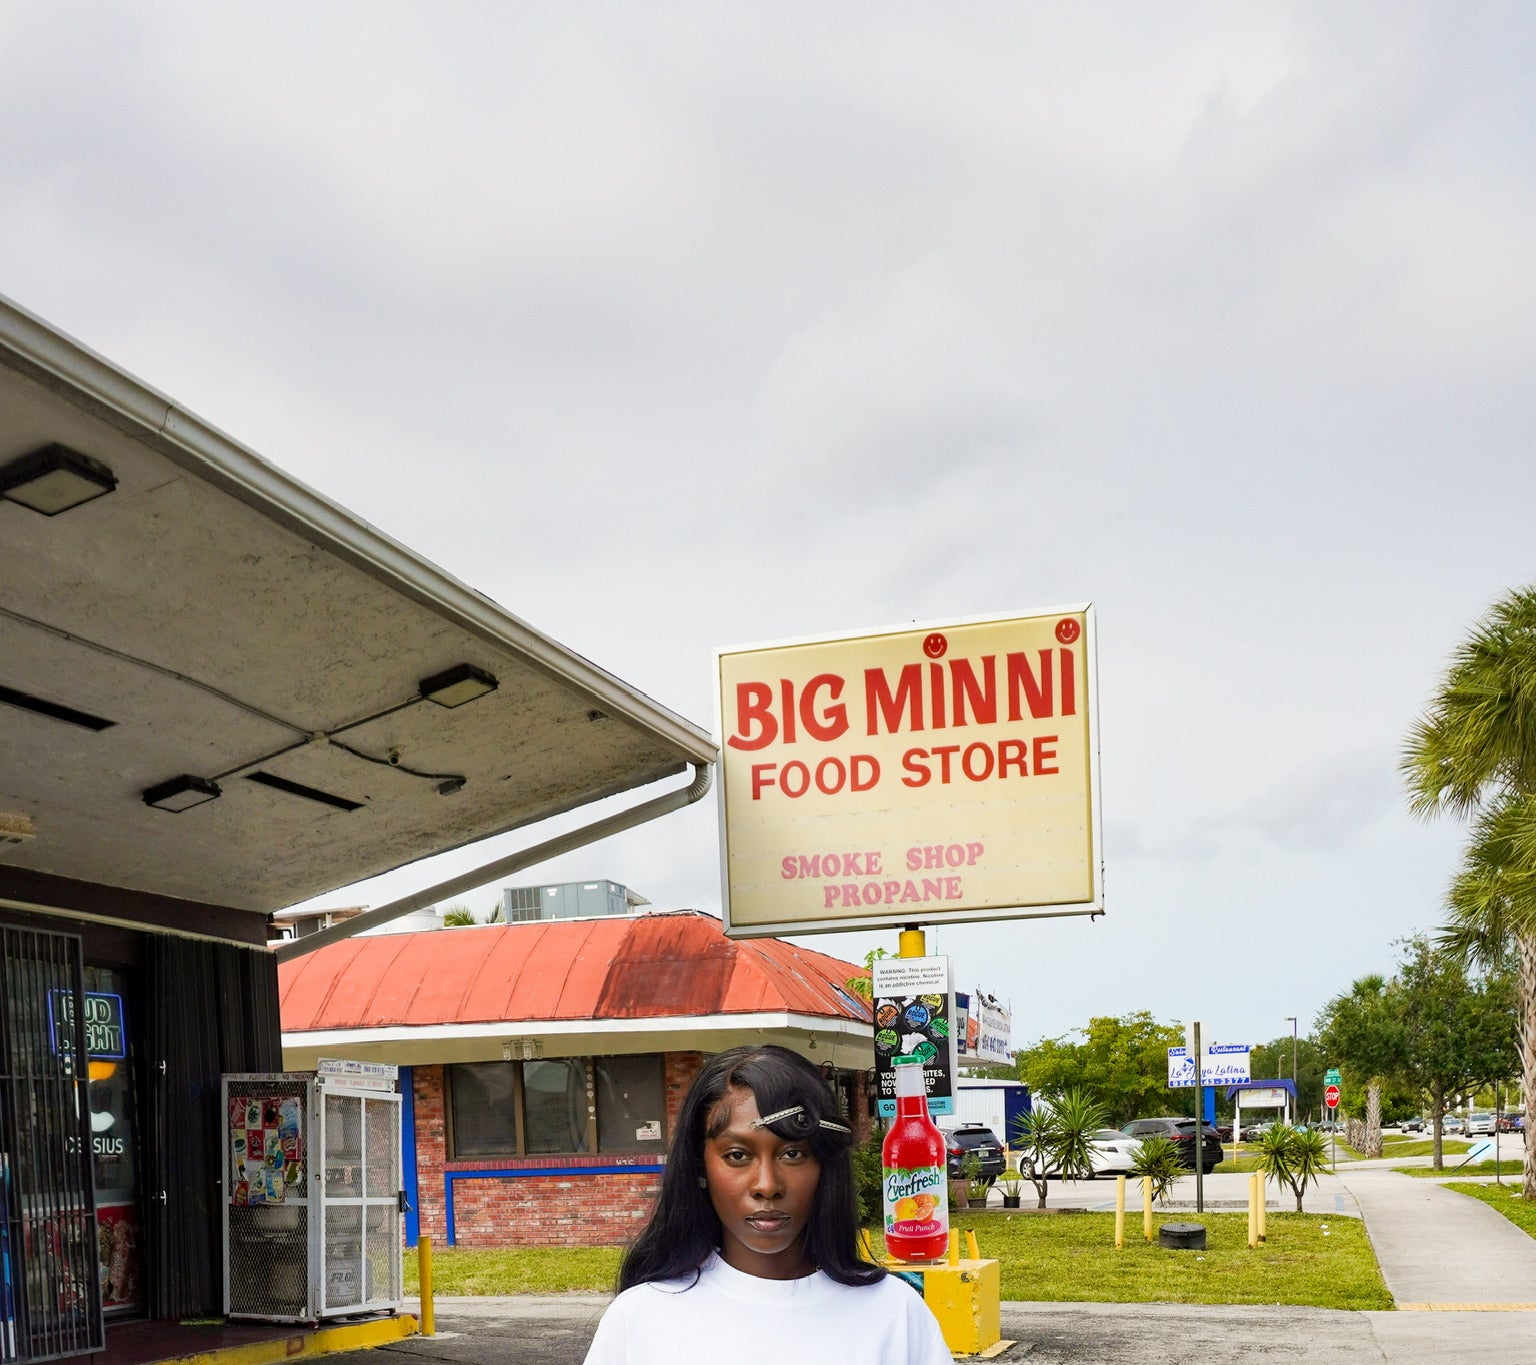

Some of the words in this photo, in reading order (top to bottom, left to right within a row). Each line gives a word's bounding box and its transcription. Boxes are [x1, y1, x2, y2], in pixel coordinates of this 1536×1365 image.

[727, 673, 850, 751] BIG
[752, 755, 881, 801] FOOD
[901, 735, 1060, 788] STORE
[781, 851, 883, 880] SMOKE
[906, 842, 985, 872] SHOP
[823, 876, 964, 909] PROPANE
[921, 965, 941, 973] product
[892, 980, 915, 988] addictive
[908, 1009, 925, 1018] ROGUE
[879, 1033, 896, 1041] ROGUE
[1211, 1045, 1247, 1054] Restaurant
[1170, 1067, 1182, 1078] La
[1186, 1065, 1213, 1079] Jya
[1215, 1064, 1247, 1076] Latina
[1326, 1092, 1339, 1101] STOP
[887, 1167, 940, 1202] Everfresh
[915, 1224, 936, 1232] Punch
